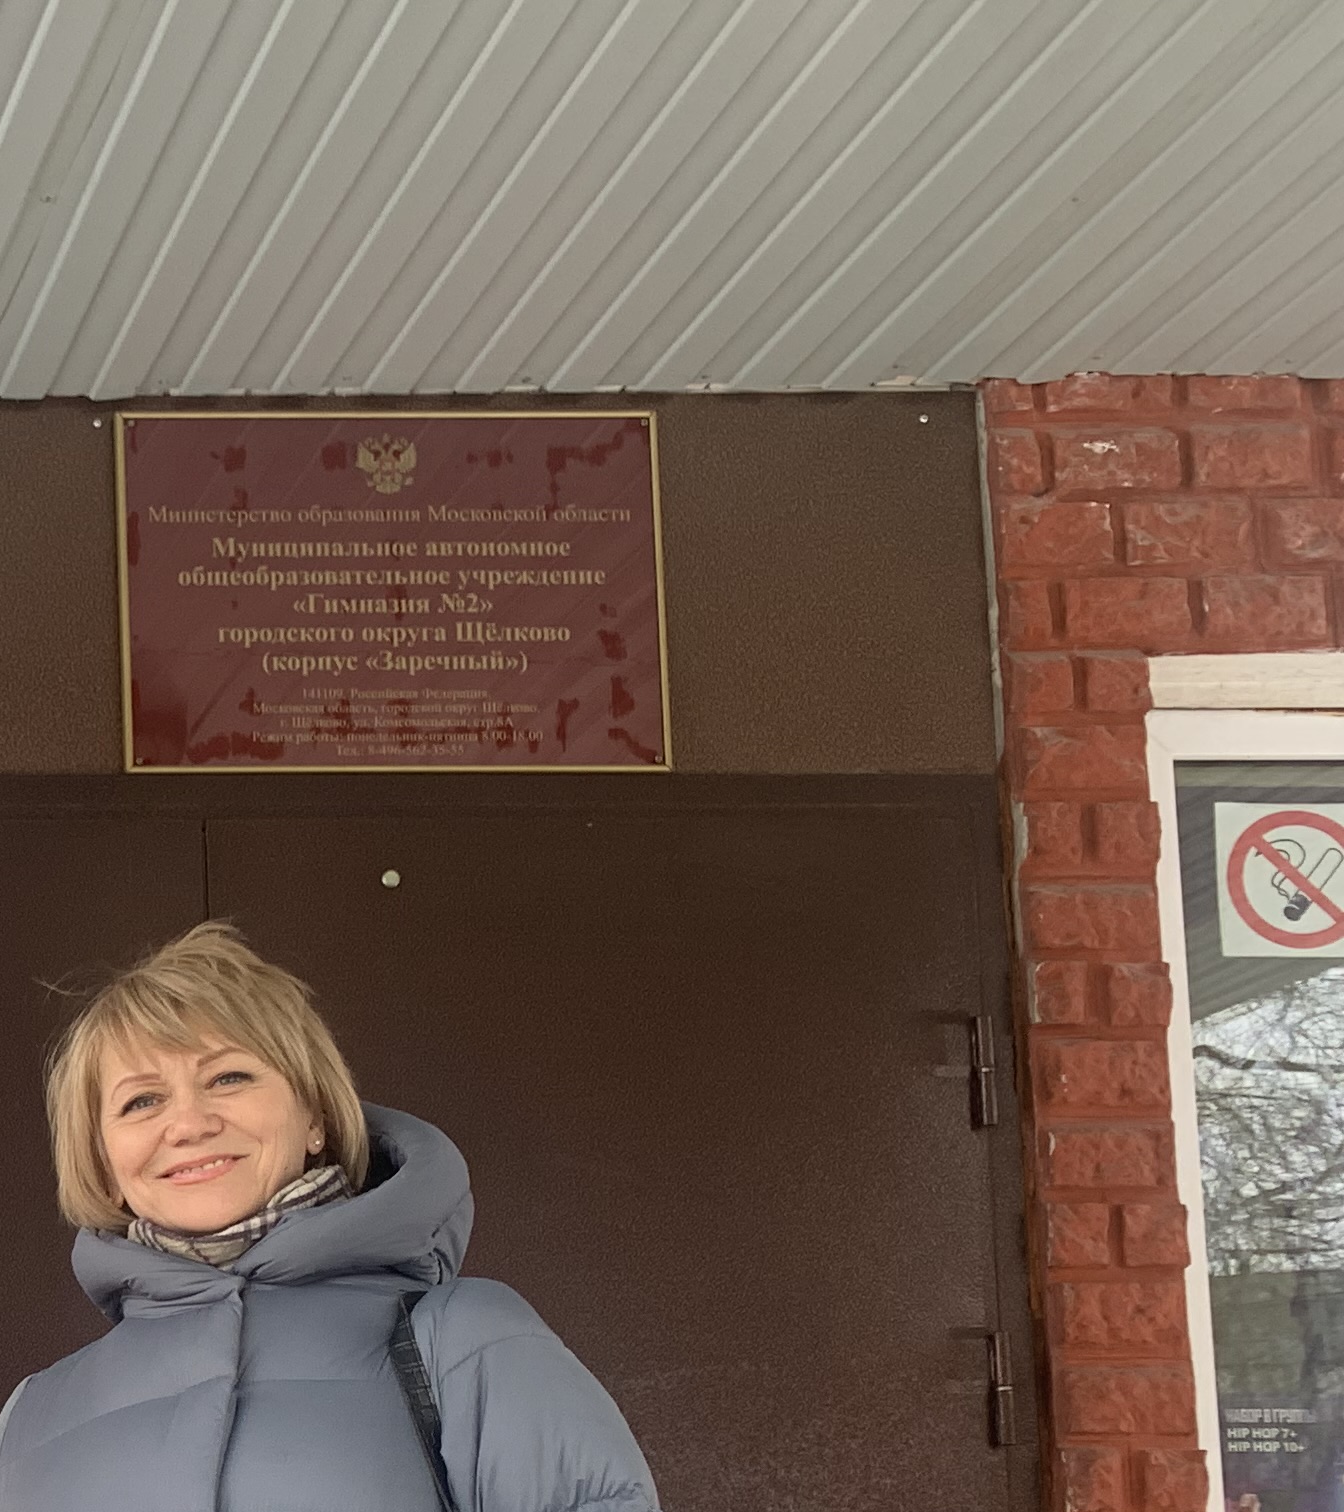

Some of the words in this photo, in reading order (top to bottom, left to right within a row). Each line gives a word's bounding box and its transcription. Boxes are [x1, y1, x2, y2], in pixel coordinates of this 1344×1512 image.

[148, 505, 292, 528] Министерство
[298, 504, 420, 527] образования
[428, 504, 547, 522] Московской
[554, 504, 631, 522] области
[213, 537, 417, 563] Муниципальное
[425, 541, 571, 557] автономное
[178, 566, 450, 591] общеобразовательное
[458, 569, 606, 590] учреждение
[293, 593, 430, 614] «Гимназия
[218, 626, 354, 648] городского
[362, 626, 446, 647] округа
[456, 621, 571, 646] Щёлково
[262, 652, 357, 677] (корпус
[365, 650, 528, 676] «Заречный»)
[1227, 1427, 1250, 1438] HIP
[1252, 1427, 1280, 1438] HOP
[1228, 1441, 1251, 1452] HIP
[1253, 1441, 1281, 1452] HOP
